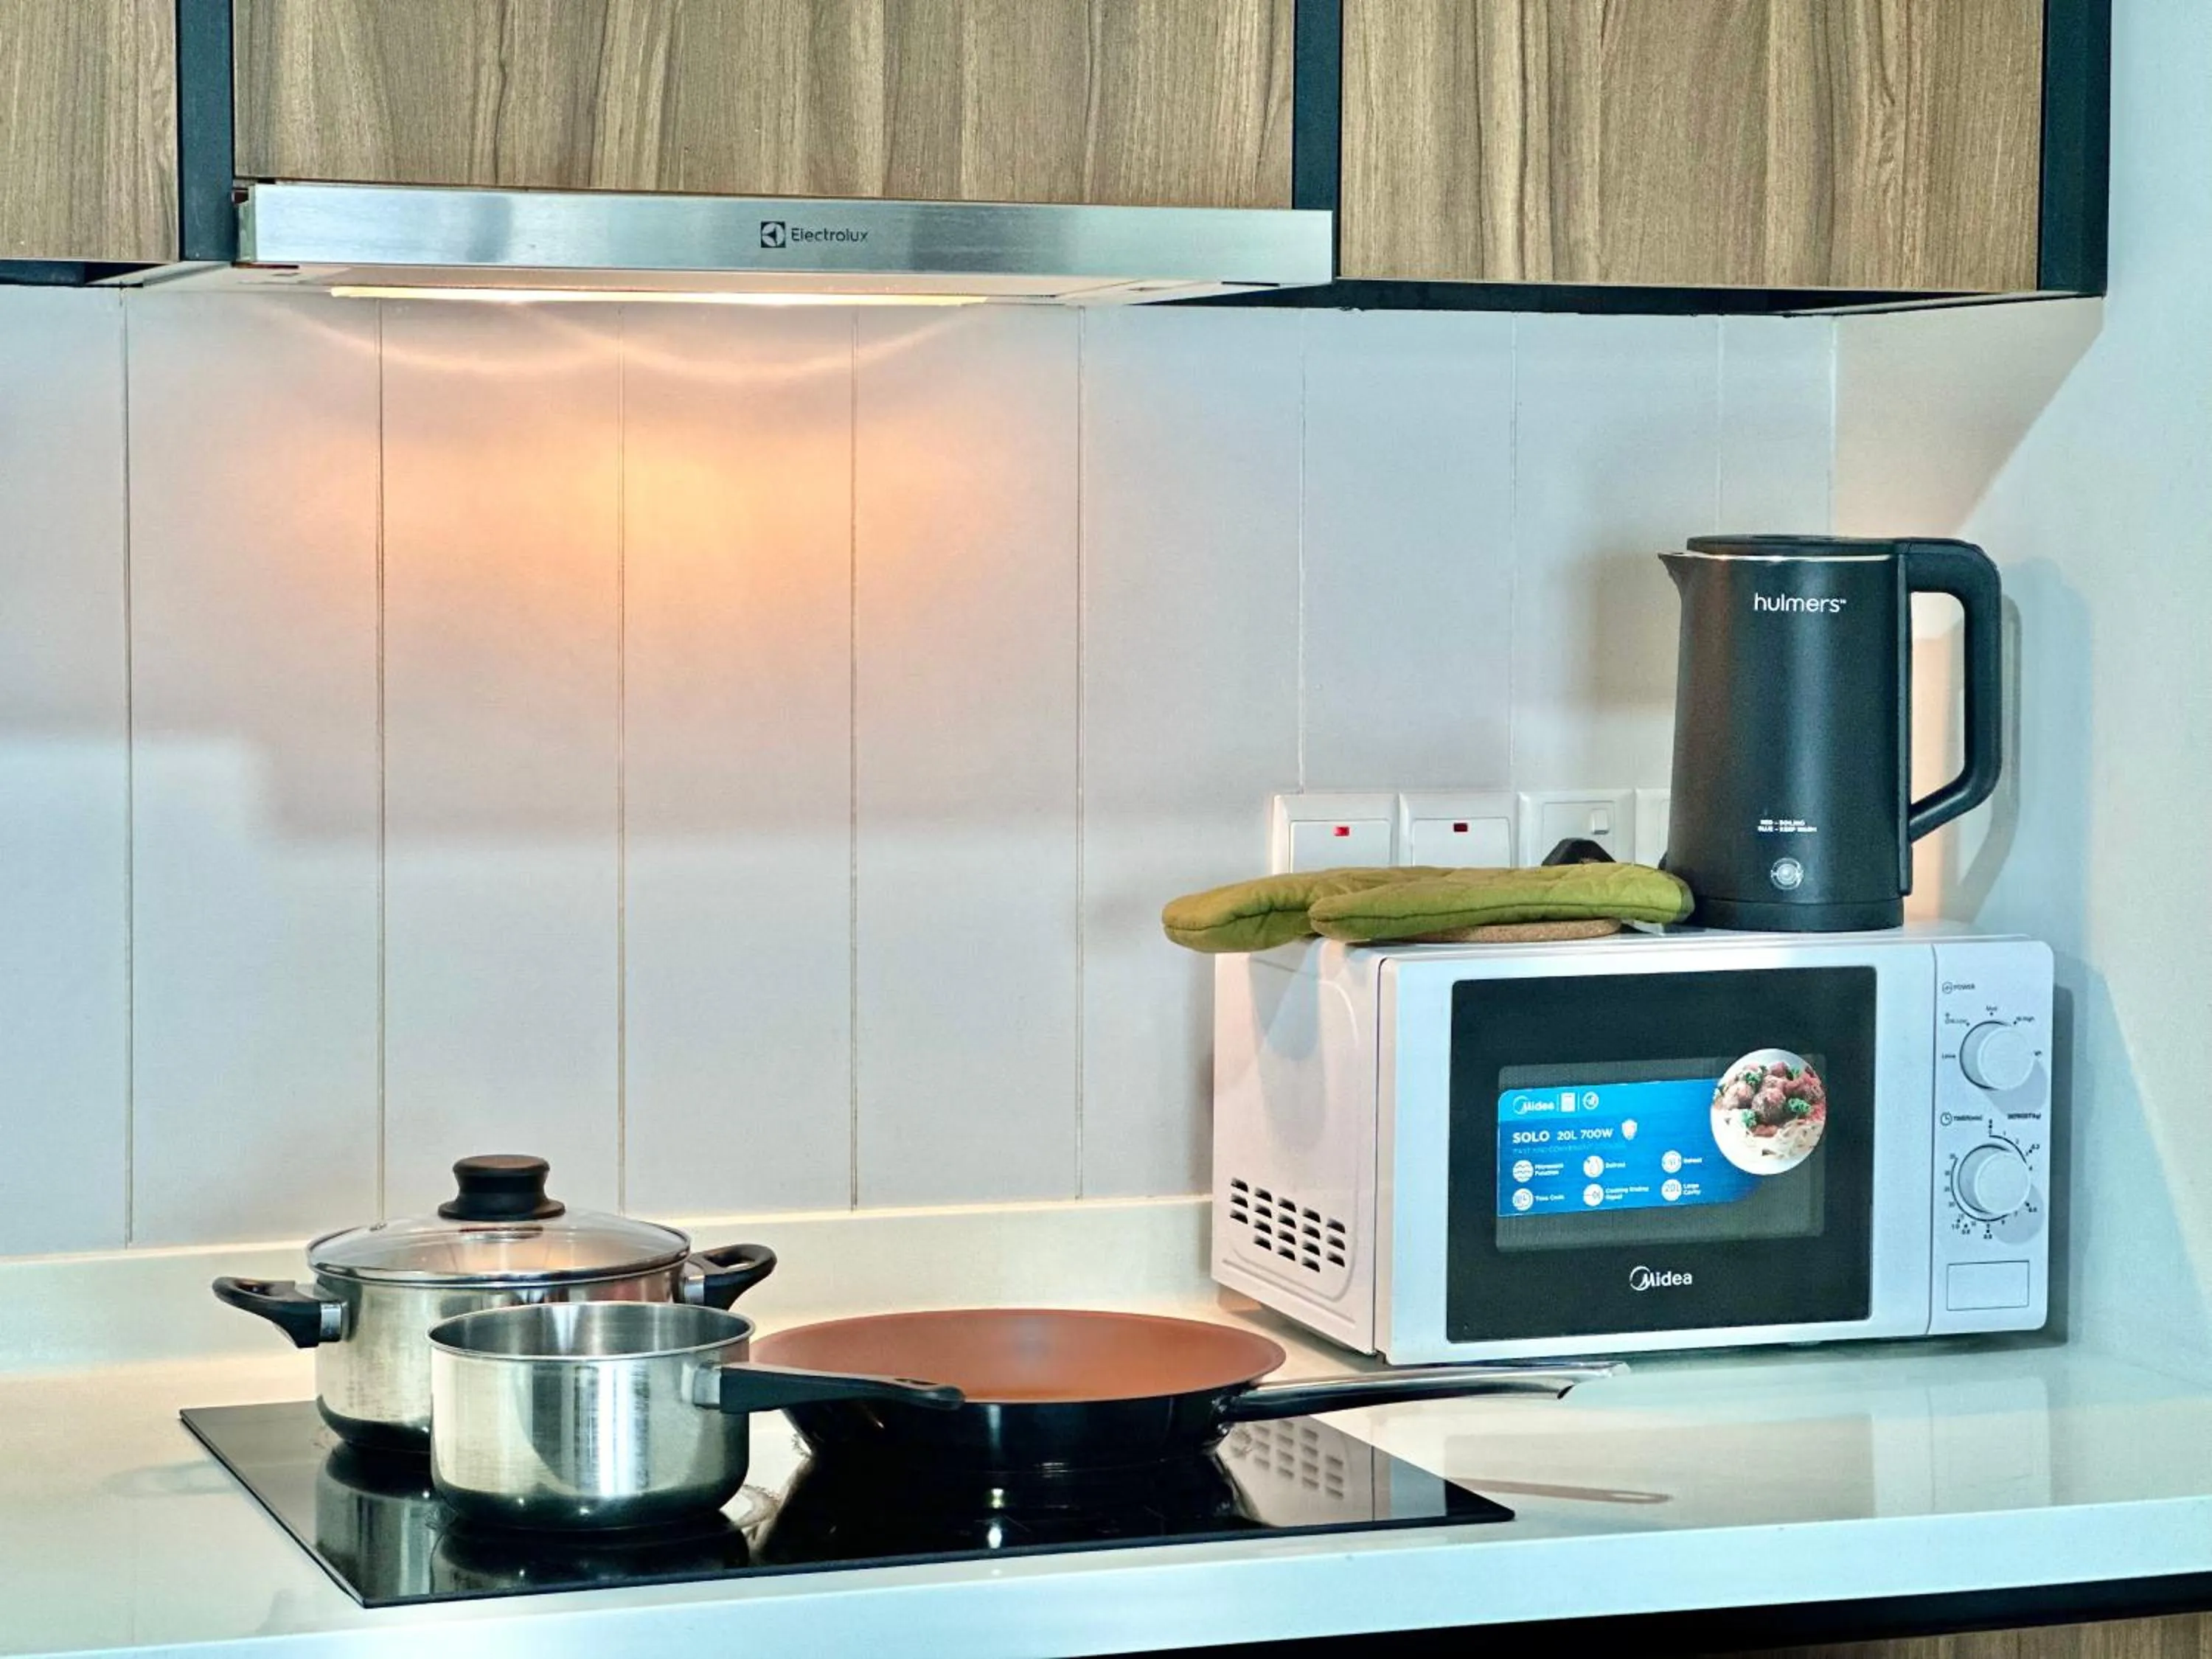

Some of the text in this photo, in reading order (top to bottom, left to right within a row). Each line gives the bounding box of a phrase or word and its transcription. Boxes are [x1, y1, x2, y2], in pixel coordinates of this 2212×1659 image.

[791, 227, 869, 243] Electrolux
[1753, 592, 1841, 613] hulmers
[1512, 1095, 1555, 1116] Midea
[1512, 1128, 1614, 1144] SOLO 20L 700W
[1629, 1265, 1692, 1291] Midea
